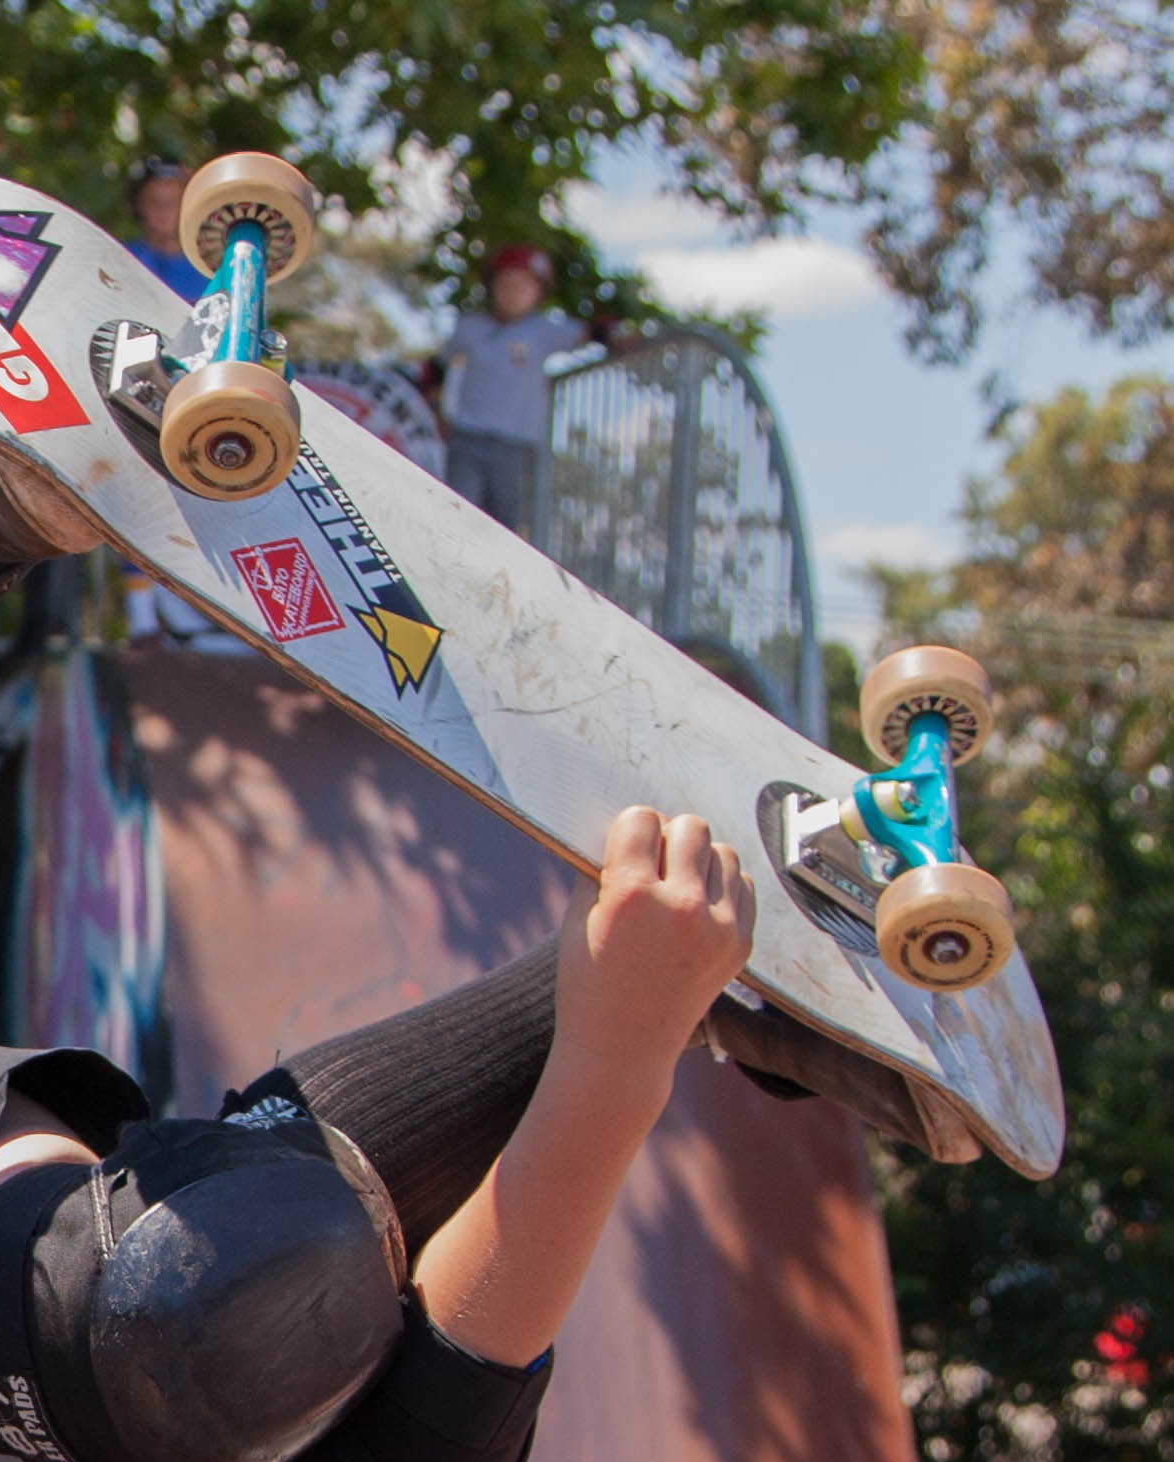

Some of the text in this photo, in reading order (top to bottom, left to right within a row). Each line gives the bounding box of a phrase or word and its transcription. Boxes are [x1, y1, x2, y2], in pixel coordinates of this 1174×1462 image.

[287, 455, 393, 606] THEE
[299, 437, 403, 583] TITANIUM TRU
[8, 1375, 46, 1437] PADS
